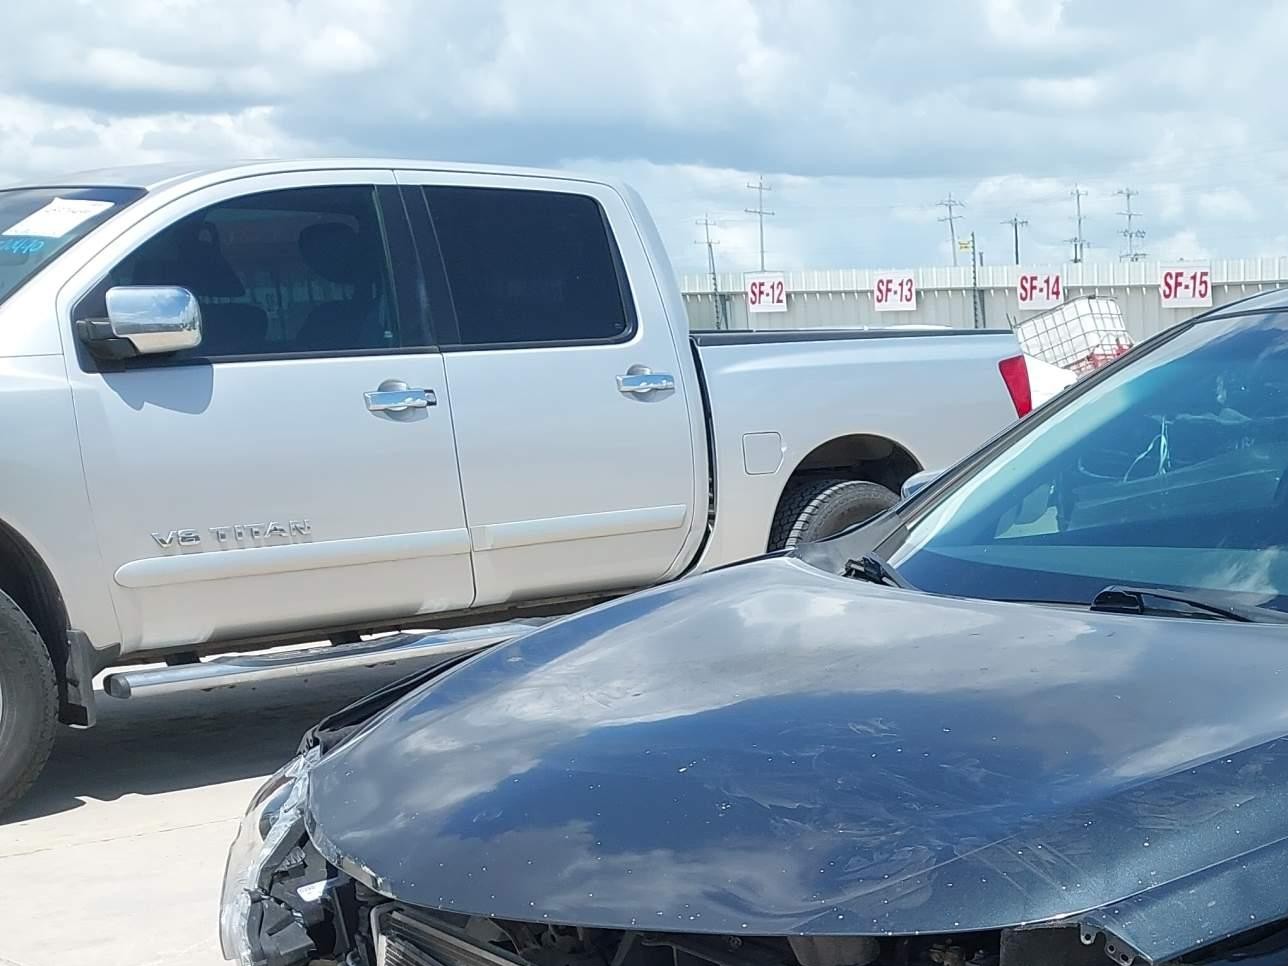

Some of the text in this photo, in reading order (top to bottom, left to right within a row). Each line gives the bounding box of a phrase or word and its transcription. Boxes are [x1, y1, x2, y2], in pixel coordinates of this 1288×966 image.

[750, 281, 784, 305] SF-12
[875, 278, 914, 303] SF-13
[1019, 275, 1061, 301] SF-14
[1162, 271, 1209, 299] SF-15
[208, 519, 313, 543] TITAN
